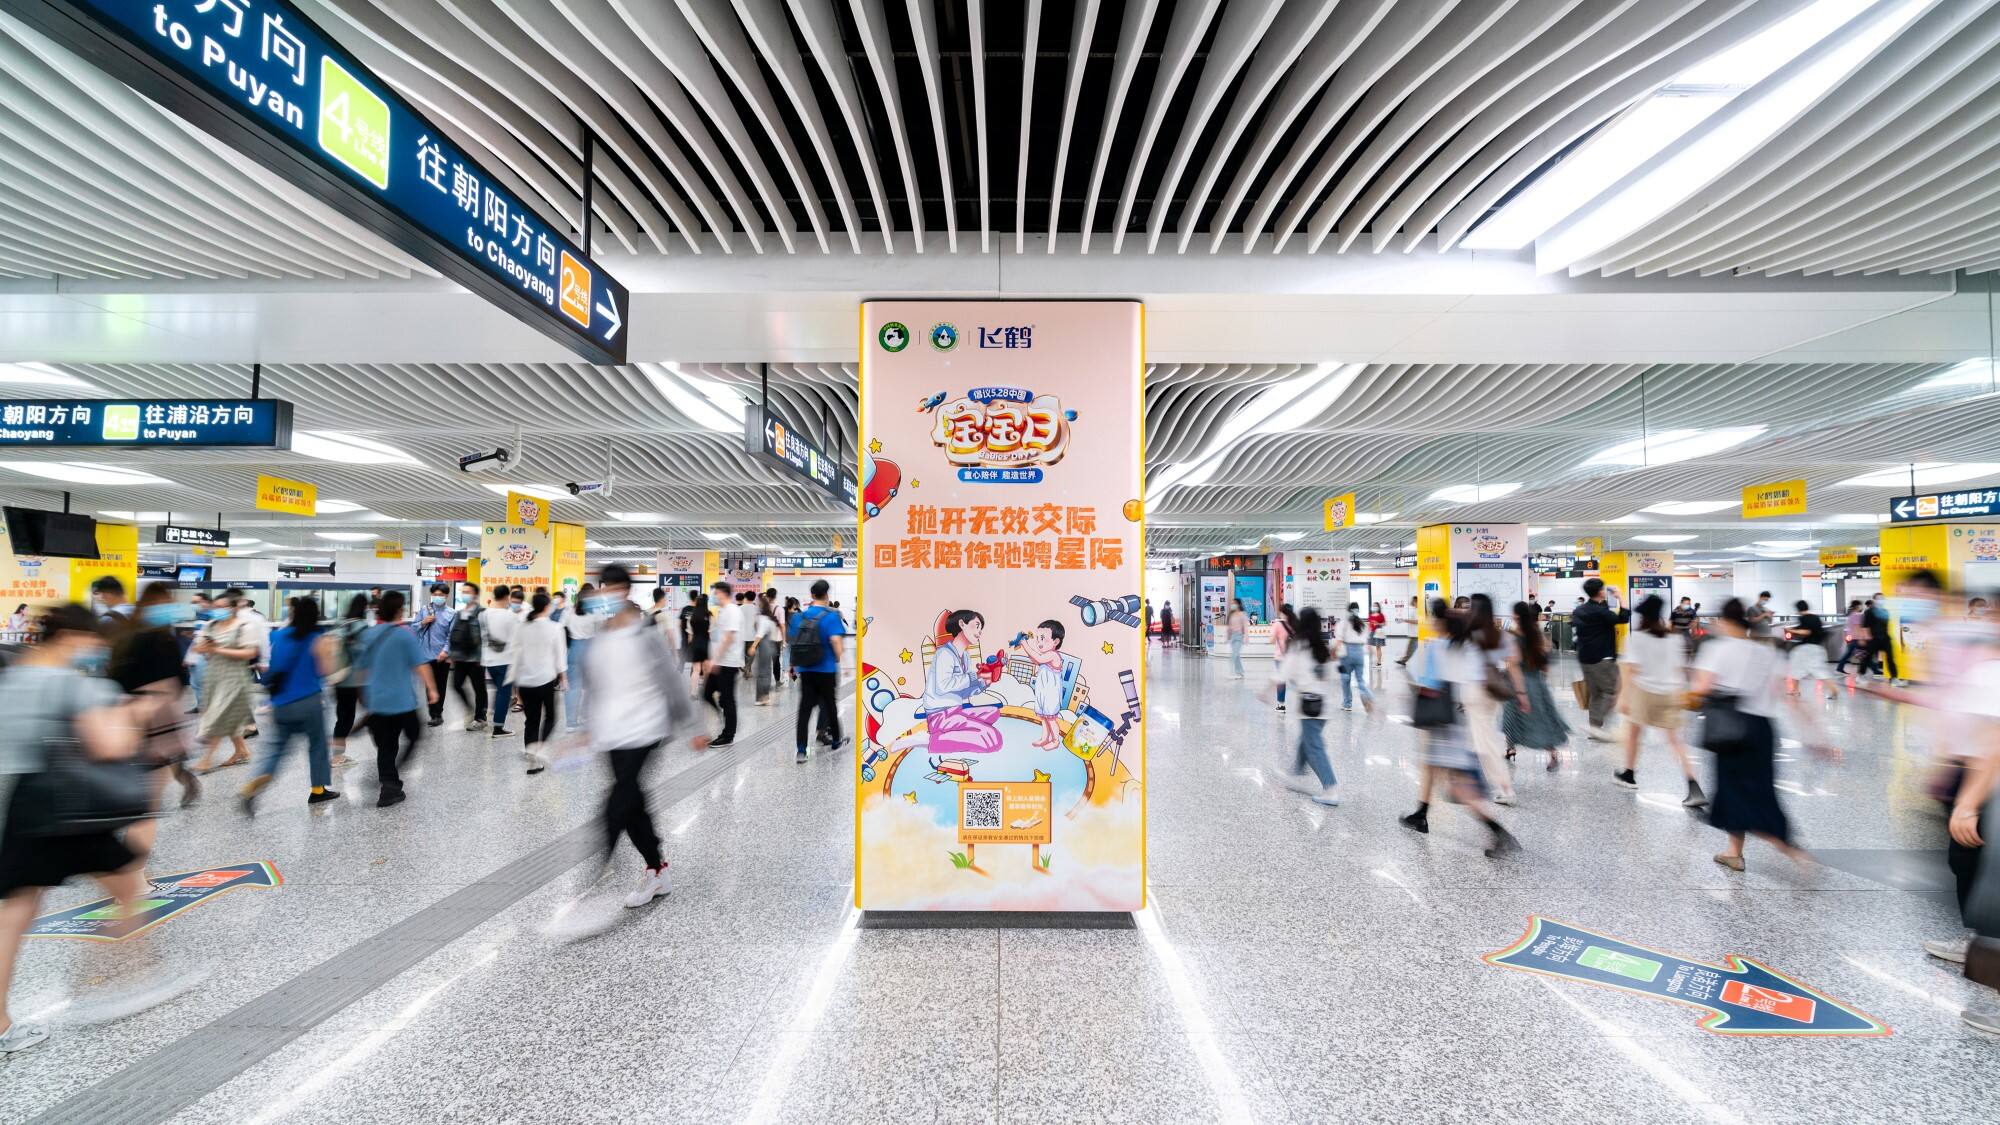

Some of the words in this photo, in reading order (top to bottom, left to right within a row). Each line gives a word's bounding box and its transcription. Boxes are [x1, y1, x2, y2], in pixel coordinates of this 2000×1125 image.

[153, 4, 192, 50] to
[202, 35, 303, 130] Puyan
[416, 134, 555, 276] 往朝阳方向
[467, 226, 484, 252] to
[487, 241, 554, 305] Chaoyang
[977, 326, 1032, 349] 飞鹤
[973, 388, 1028, 401] 倡议5.28中国
[0, 404, 91, 425] 朝阳方向
[145, 404, 254, 425] 往浦沿方向
[0, 428, 54, 441] haoyang
[143, 428, 157, 439] to
[159, 428, 197, 440] Puyan
[1941, 491, 2000, 507] 往朝阳方
[907, 502, 1097, 536] 抛开无效交际
[181, 529, 213, 540] 客服中心
[874, 536, 1124, 571] 回家陪你驰骋星际
